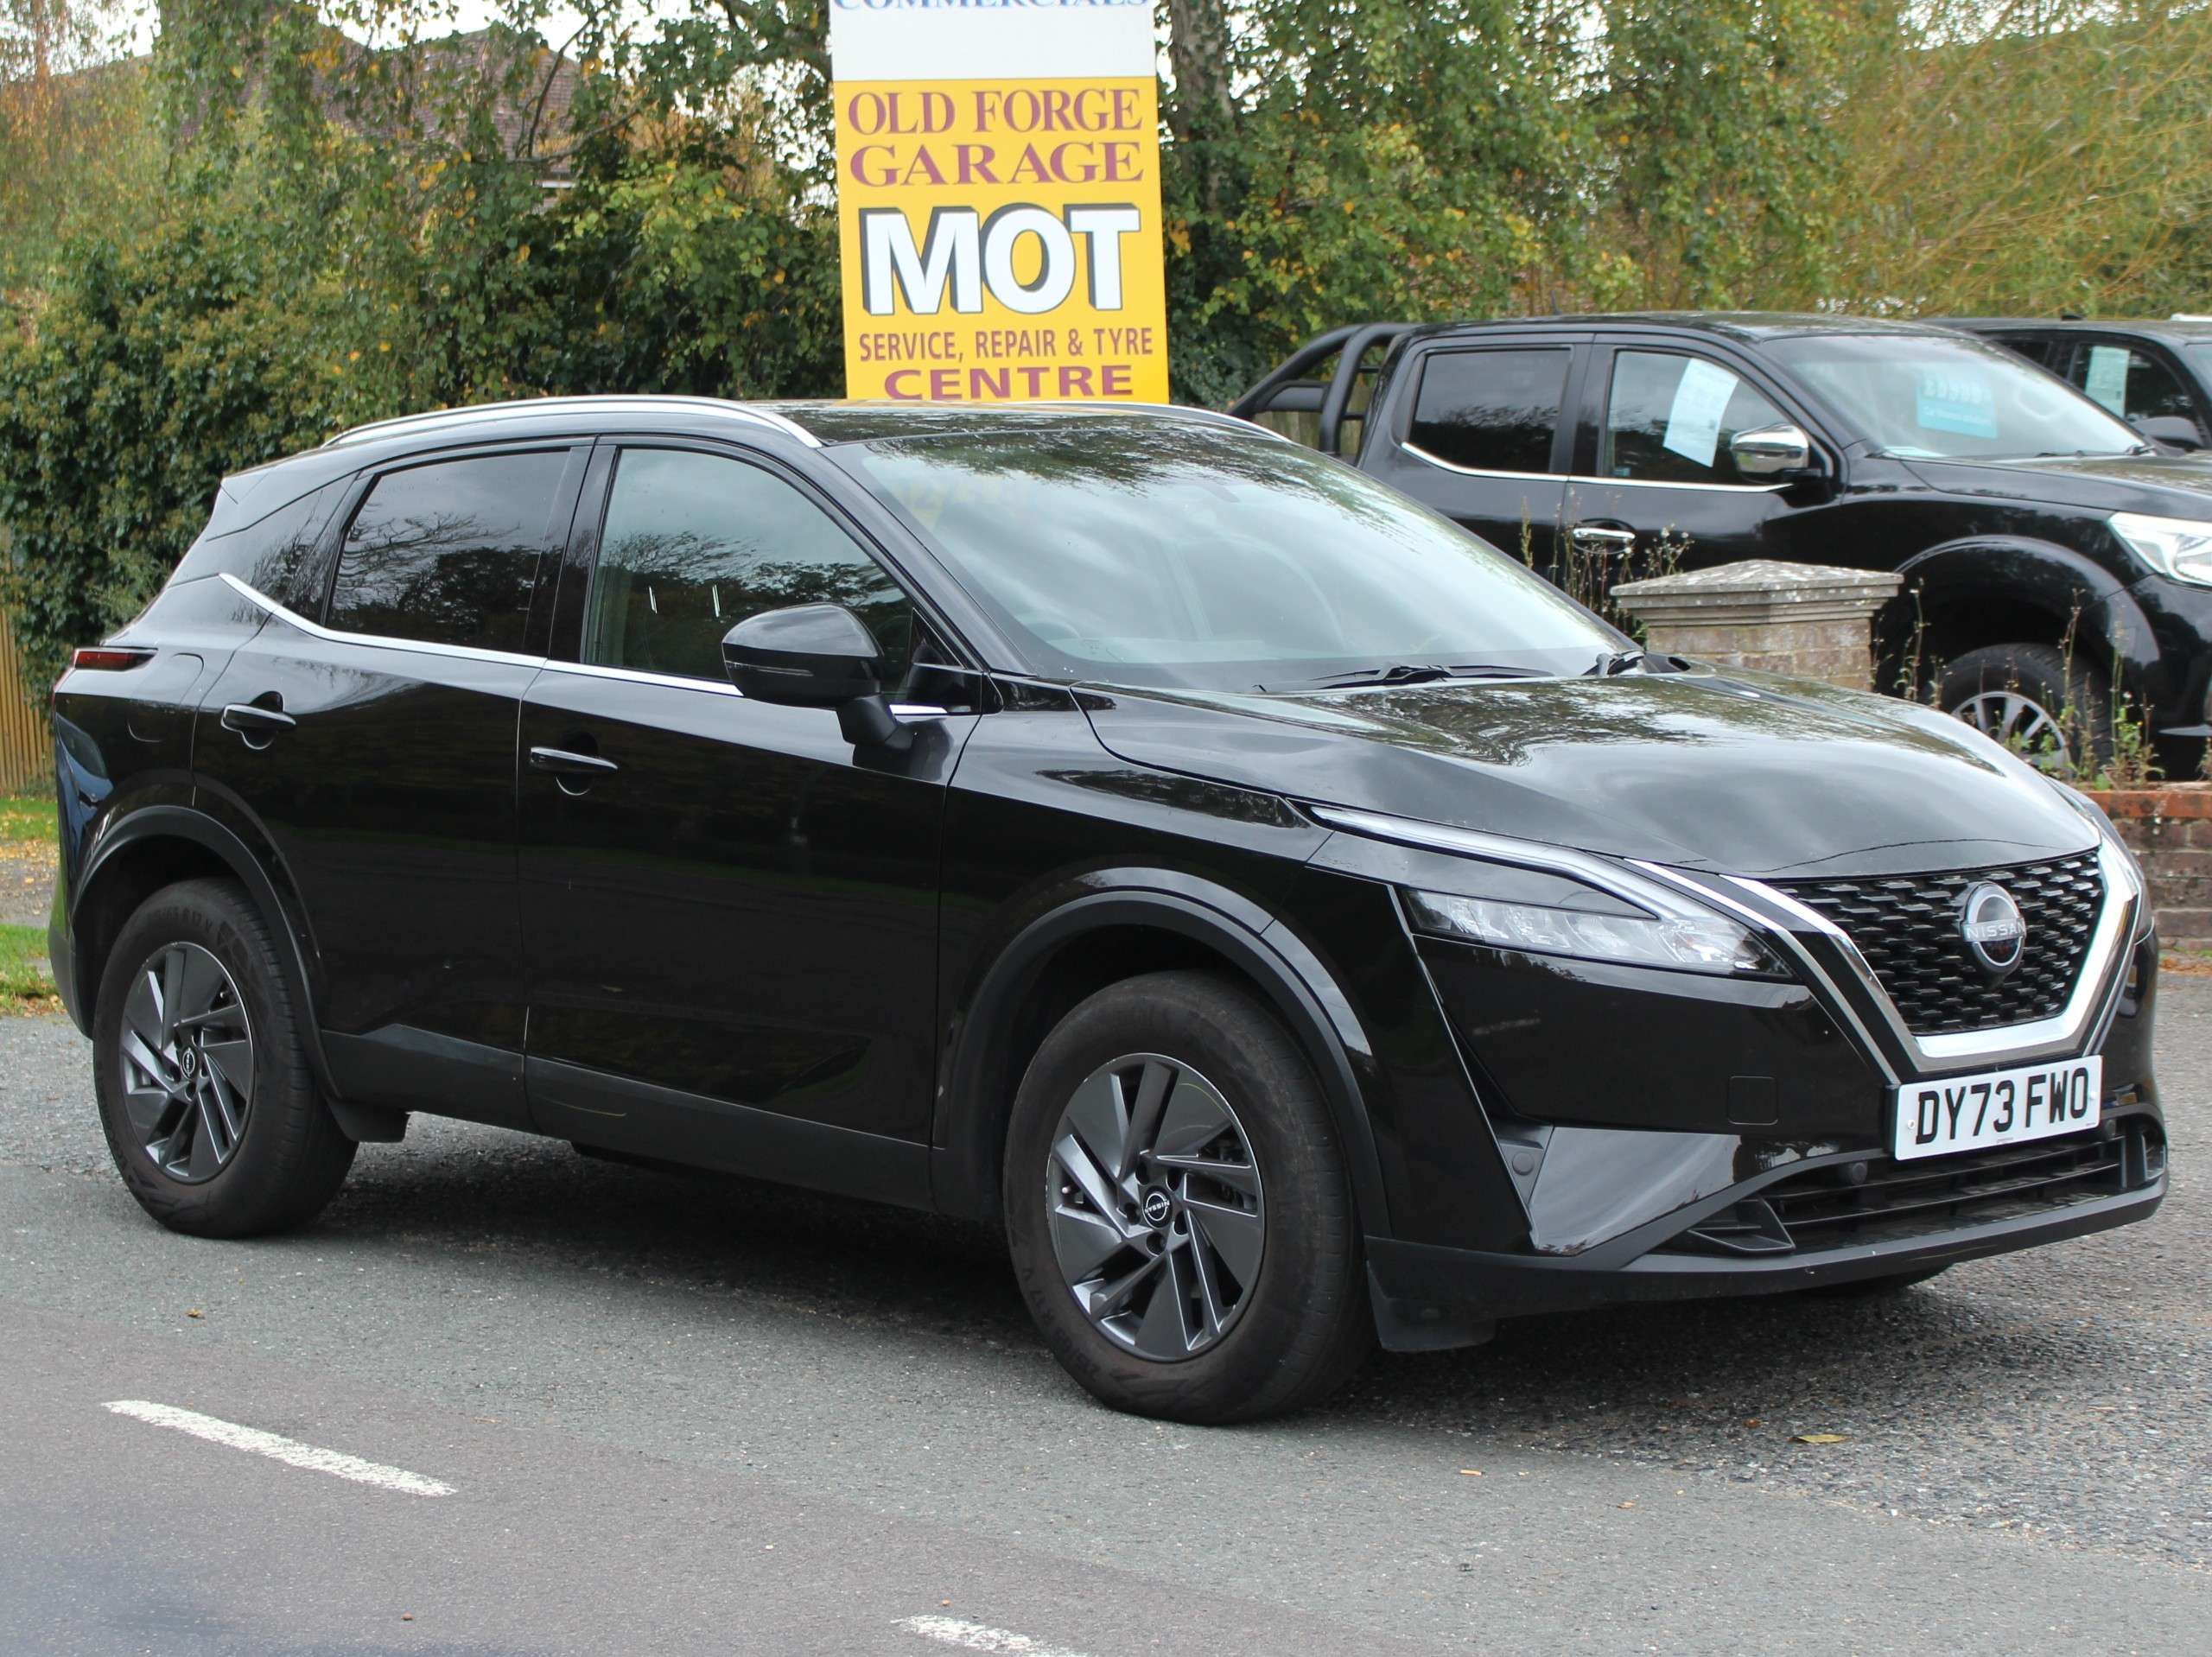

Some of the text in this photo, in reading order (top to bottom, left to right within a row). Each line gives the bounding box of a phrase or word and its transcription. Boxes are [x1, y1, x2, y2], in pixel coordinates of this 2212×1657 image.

[849, 88, 1143, 136] OLD FORGE
[850, 142, 1144, 187] GARAGE
[858, 202, 1141, 316] MOT
[860, 327, 1154, 363] SERVICE, REPAIR & TYRE
[884, 365, 1134, 400] CENTRE
[1966, 920, 2026, 939] NISSAN
[1915, 1066, 2090, 1146] DY73 FWO
